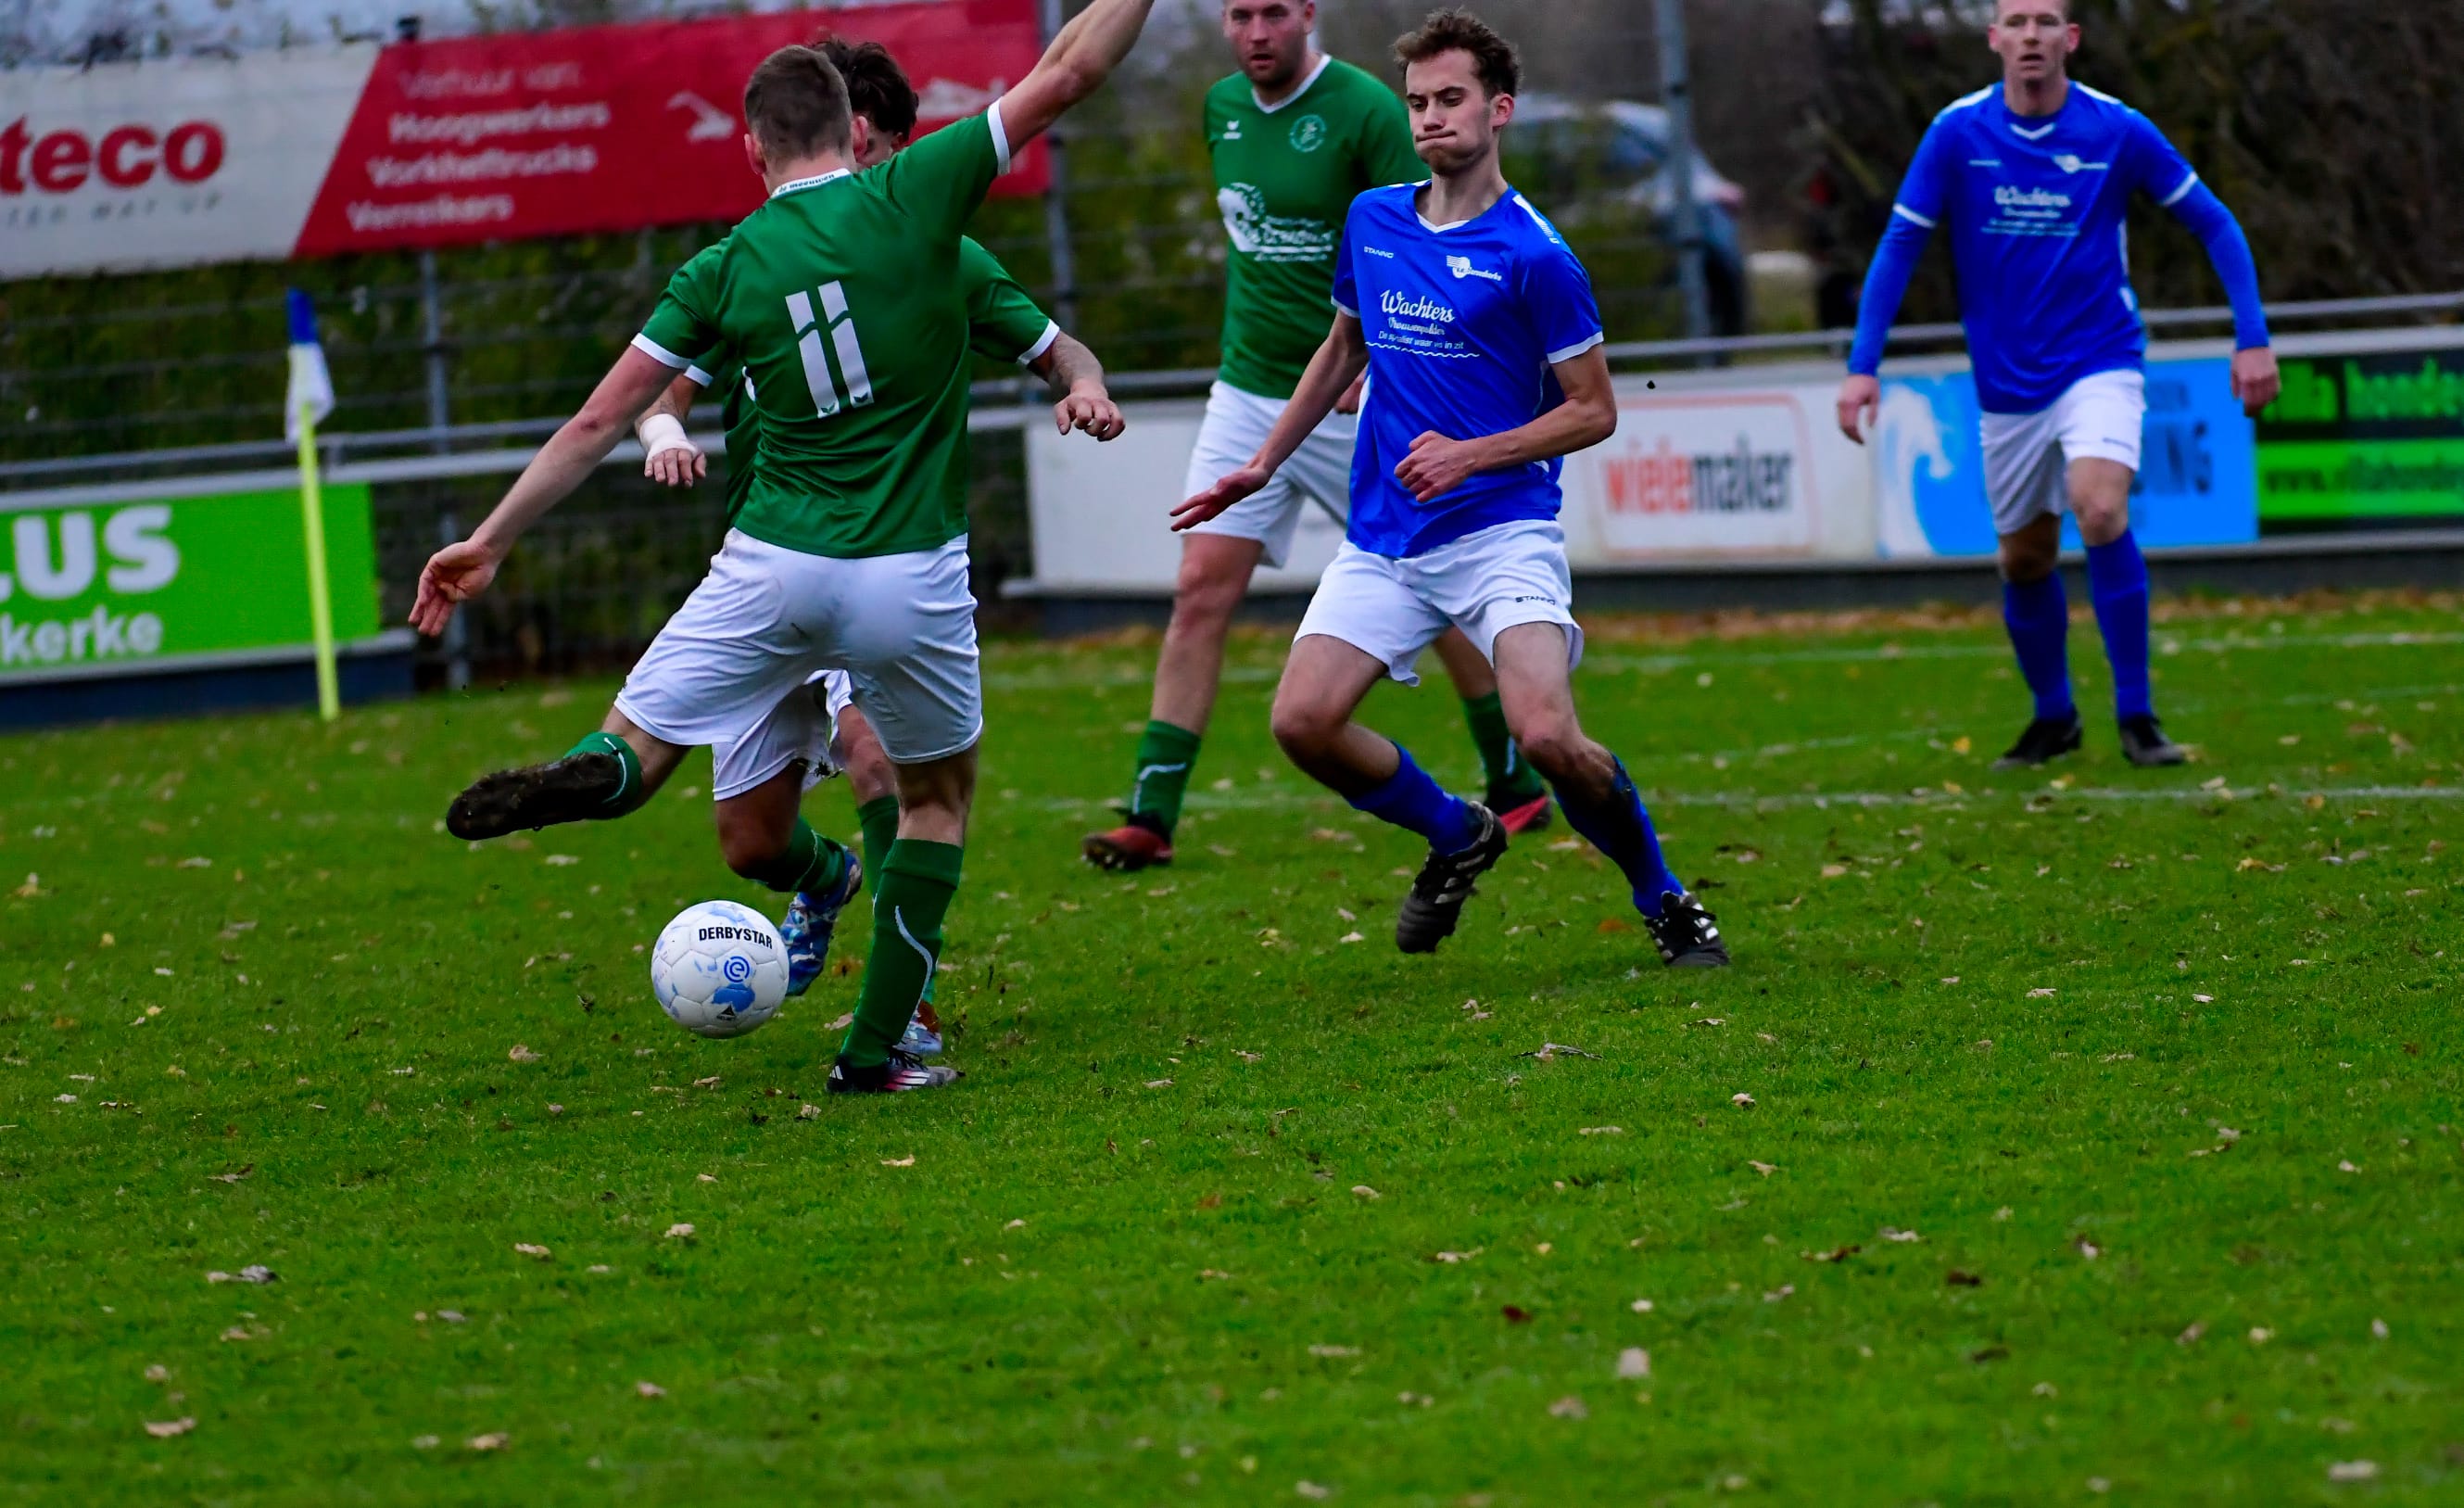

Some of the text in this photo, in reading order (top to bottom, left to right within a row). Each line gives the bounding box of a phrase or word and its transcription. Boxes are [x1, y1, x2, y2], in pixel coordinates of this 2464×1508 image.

[1380, 289, 1456, 323] Wachters
[785, 280, 875, 418] 11
[1603, 433, 1795, 515] wielemaker
[699, 927, 773, 949] DERBYSTAR
